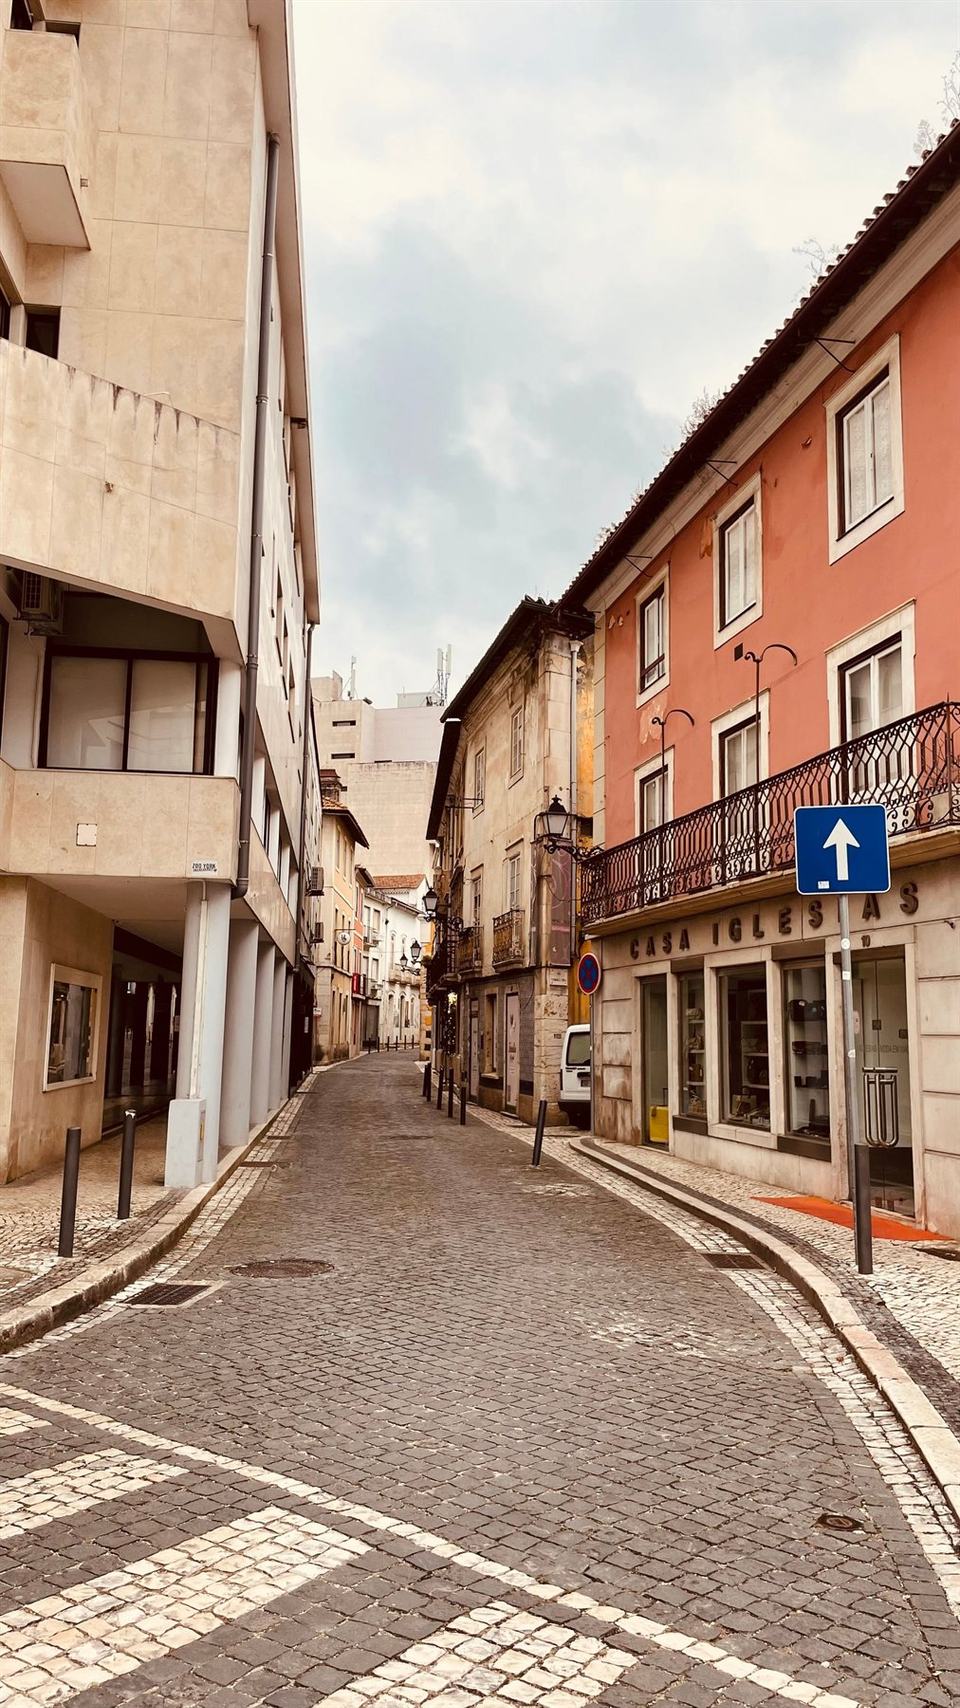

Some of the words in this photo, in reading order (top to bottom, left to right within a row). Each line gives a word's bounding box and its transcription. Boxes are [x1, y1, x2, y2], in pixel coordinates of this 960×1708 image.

[630, 928, 691, 960] CASA
[712, 881, 919, 946] IGLESAS
[861, 934, 871, 948] 10
